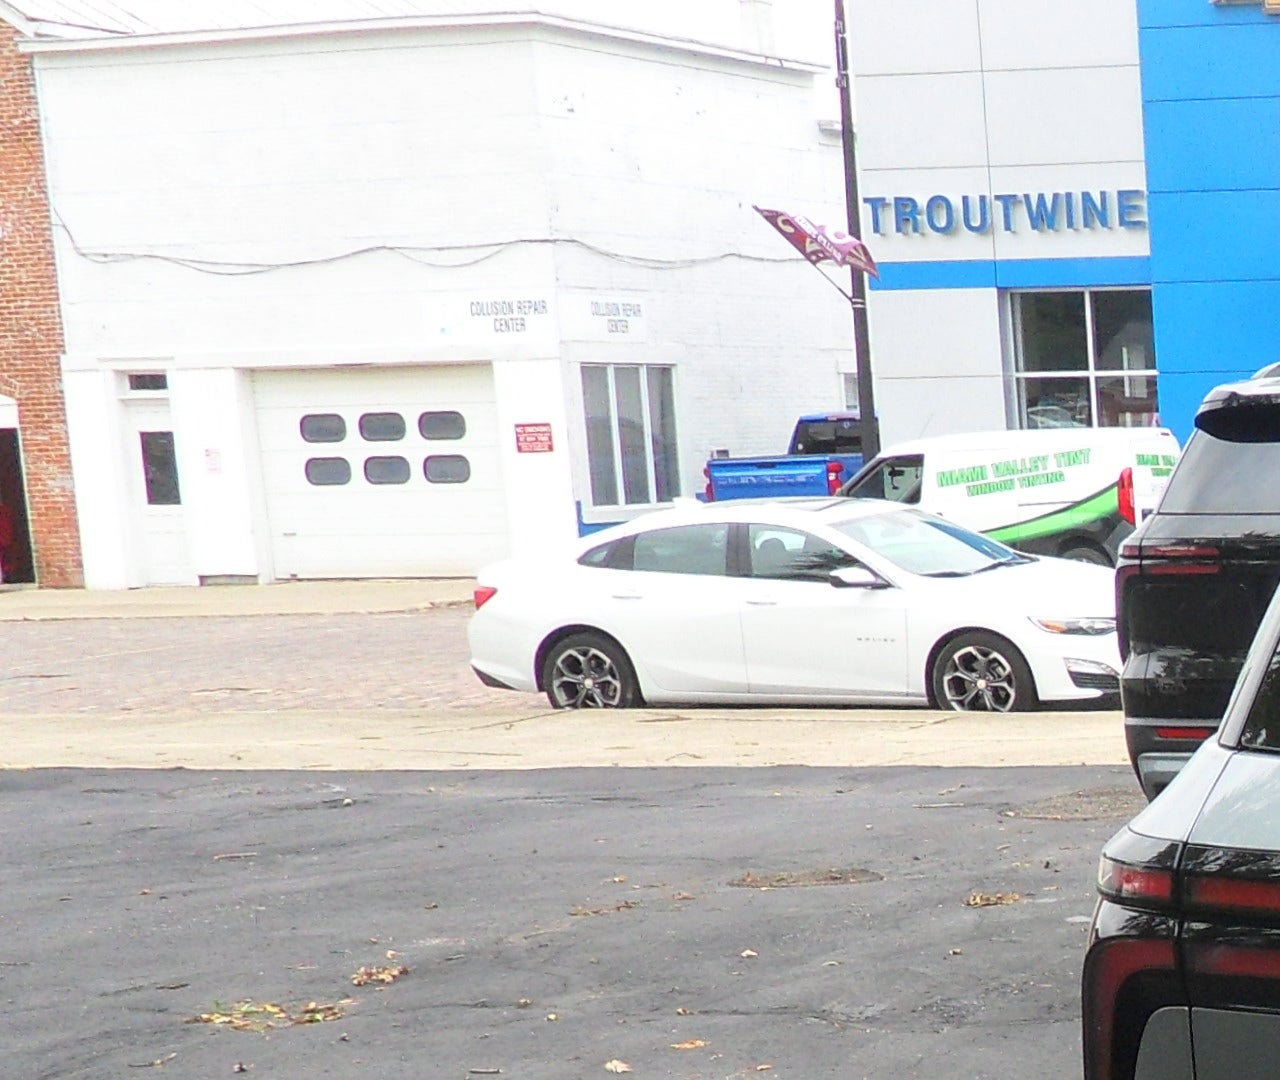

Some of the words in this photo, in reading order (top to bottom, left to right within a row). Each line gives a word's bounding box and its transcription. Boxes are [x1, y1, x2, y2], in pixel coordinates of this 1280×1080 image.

[863, 189, 1146, 235] TROUTWINE
[470, 301, 514, 316] COLLISION
[517, 300, 548, 315] REPAIR
[591, 302, 621, 317] COLLISION
[622, 303, 643, 318] REPAIR
[493, 317, 526, 333] CENTER
[607, 319, 629, 333] CENTER
[936, 465, 988, 488] MIAMI
[991, 455, 1049, 478] VALLEY
[1054, 448, 1091, 468] TINT
[966, 478, 1015, 497] WINDOW
[1017, 470, 1065, 488] TINTING
